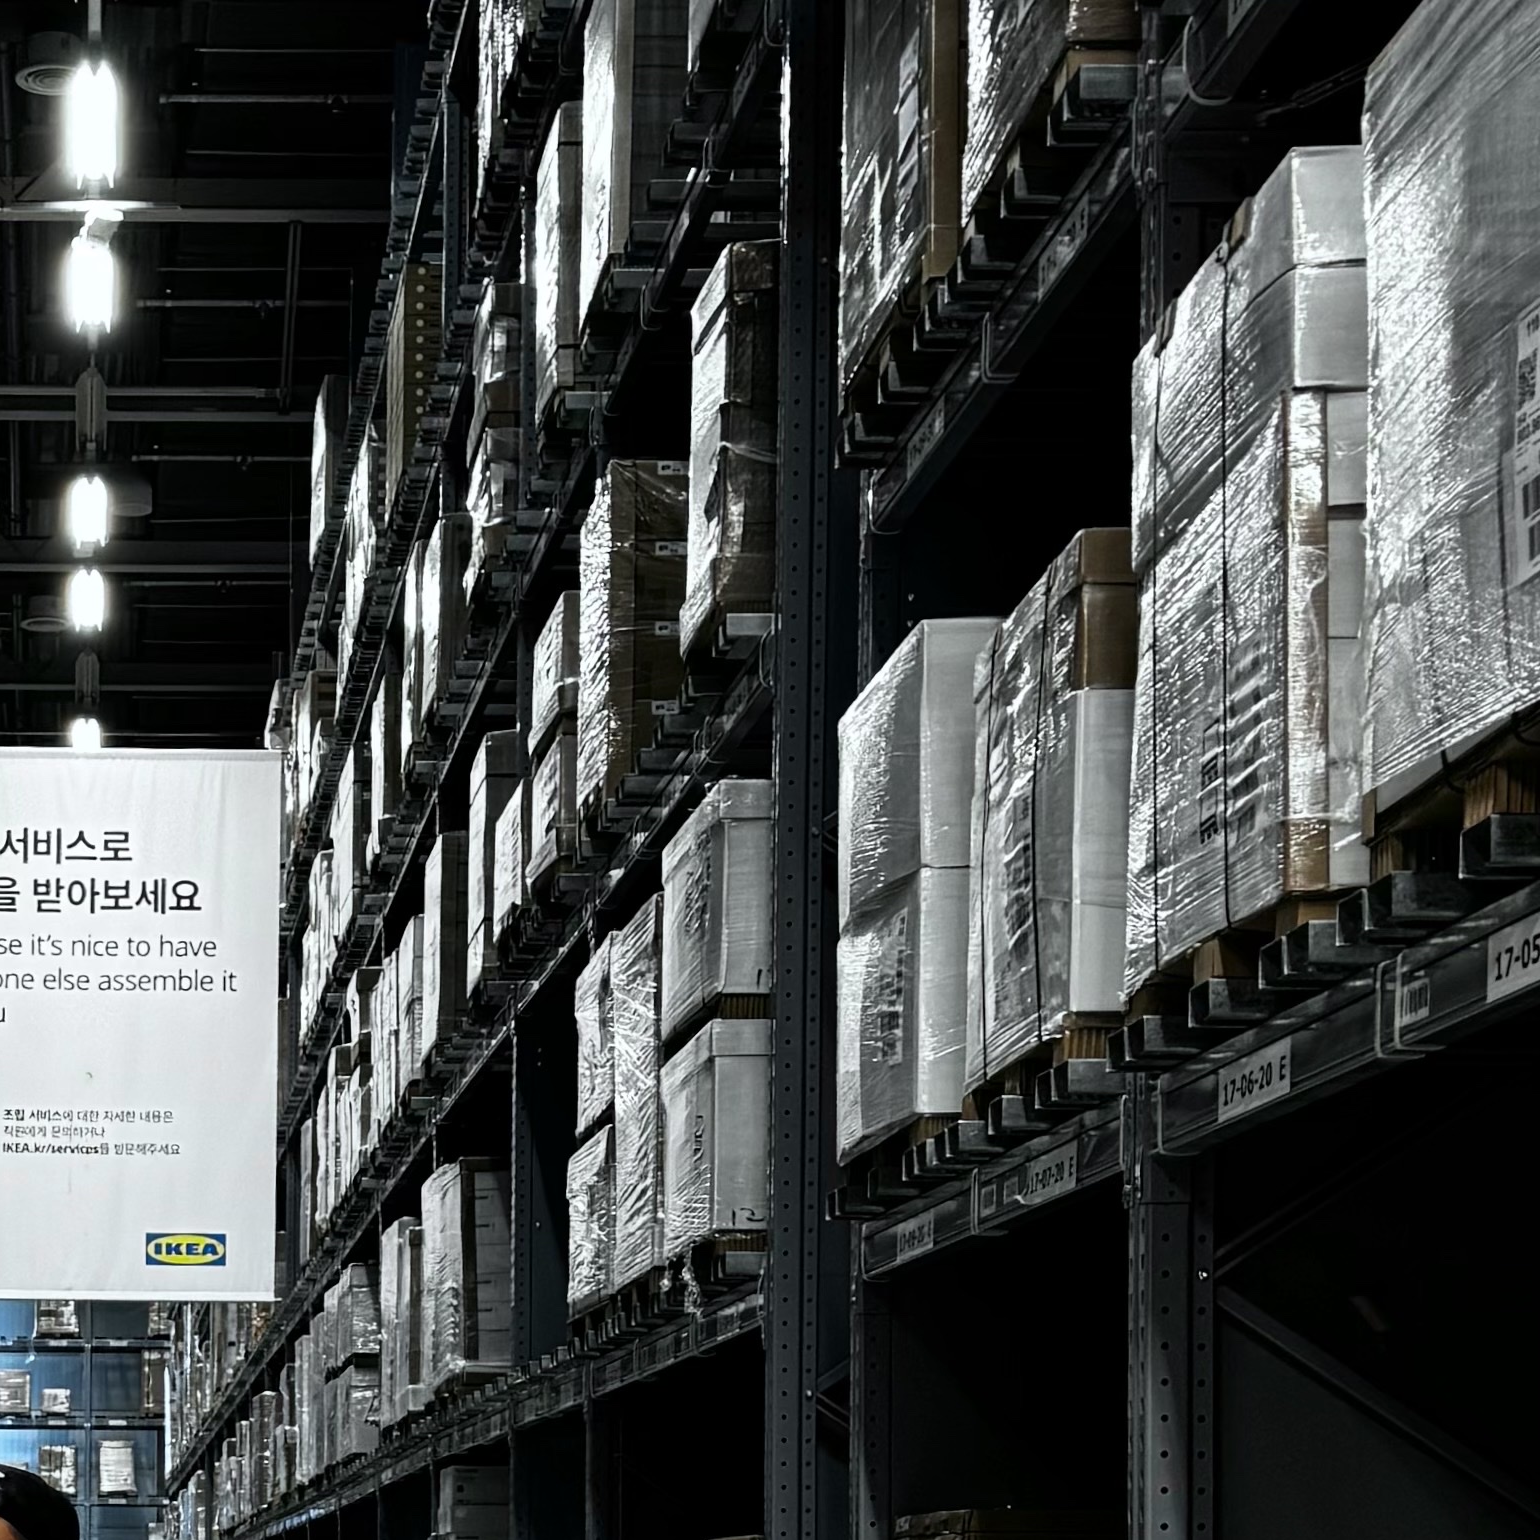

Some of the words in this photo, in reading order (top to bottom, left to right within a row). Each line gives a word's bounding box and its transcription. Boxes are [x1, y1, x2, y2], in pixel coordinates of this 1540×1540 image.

[32, 877, 203, 915] 받아보세요
[71, 935, 119, 958] nice
[127, 936, 151, 958] to
[159, 934, 218, 958] have
[43, 967, 90, 991] else
[98, 968, 214, 992] assemble
[222, 969, 238, 992] it
[1223, 1061, 1272, 1107] 17-06-20
[1279, 1055, 1286, 1081] E
[2, 1109, 25, 1121] 조립
[28, 1109, 73, 1122] 서비스에
[77, 1110, 99, 1122] 대한
[103, 1110, 136, 1123] 자세한
[139, 1110, 173, 1123] 내용은
[154, 1242, 220, 1256] IKEA
